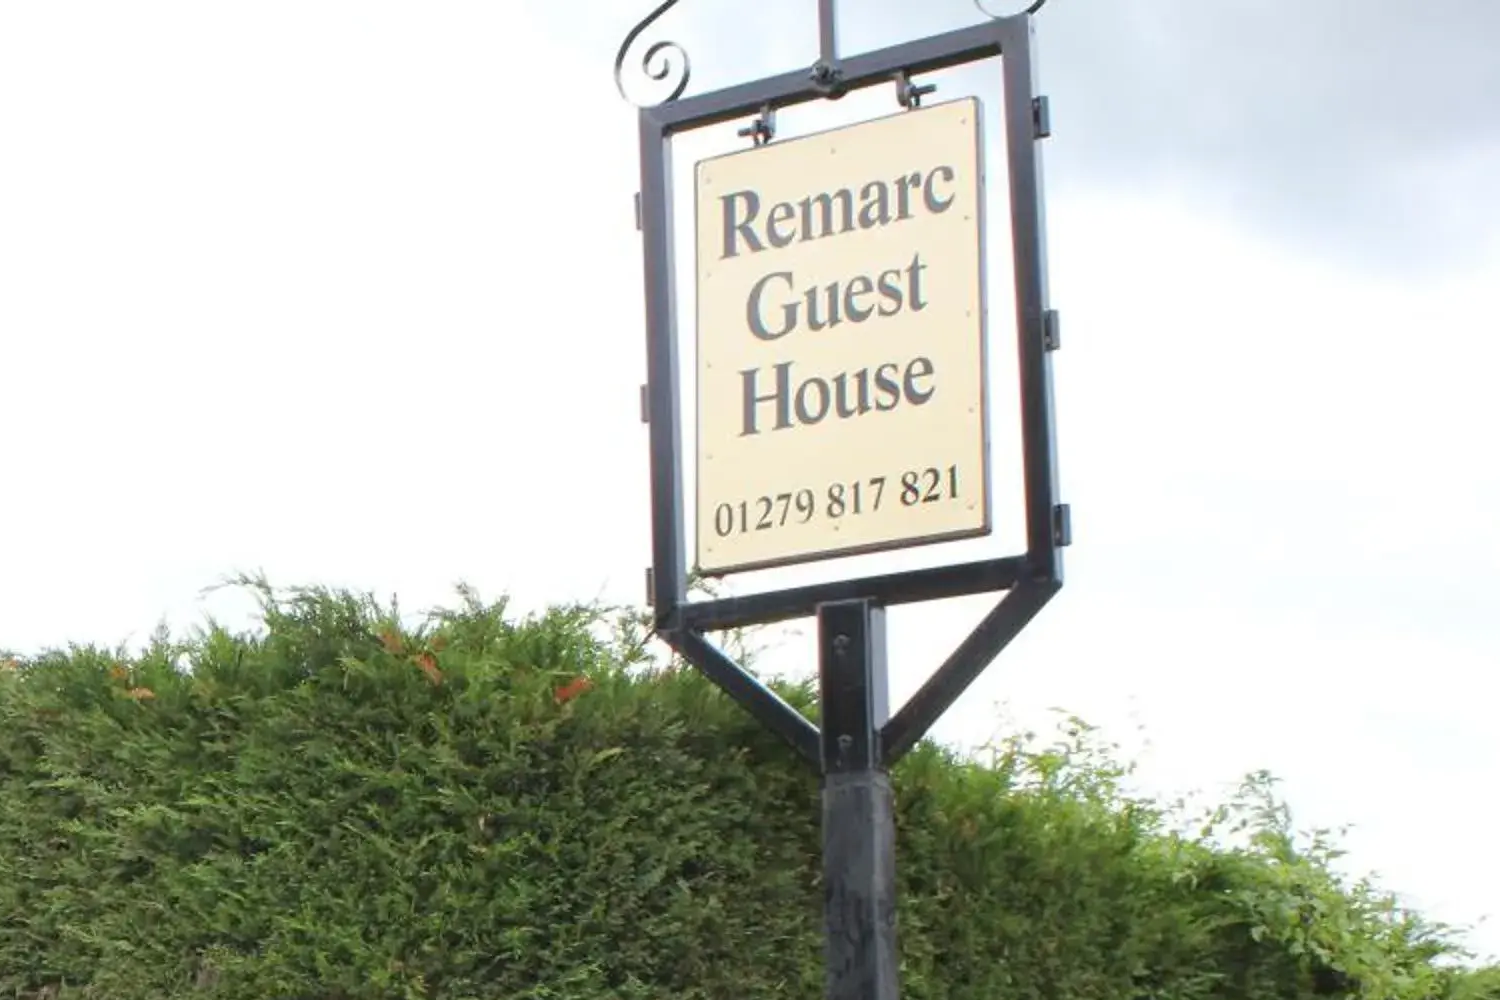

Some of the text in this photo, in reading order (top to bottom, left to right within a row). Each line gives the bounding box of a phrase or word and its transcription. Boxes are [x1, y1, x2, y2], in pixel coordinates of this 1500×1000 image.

[719, 165, 955, 259] Remarc
[746, 253, 928, 340] Guest
[738, 353, 935, 437] House
[714, 463, 959, 537] 01279 817 821
